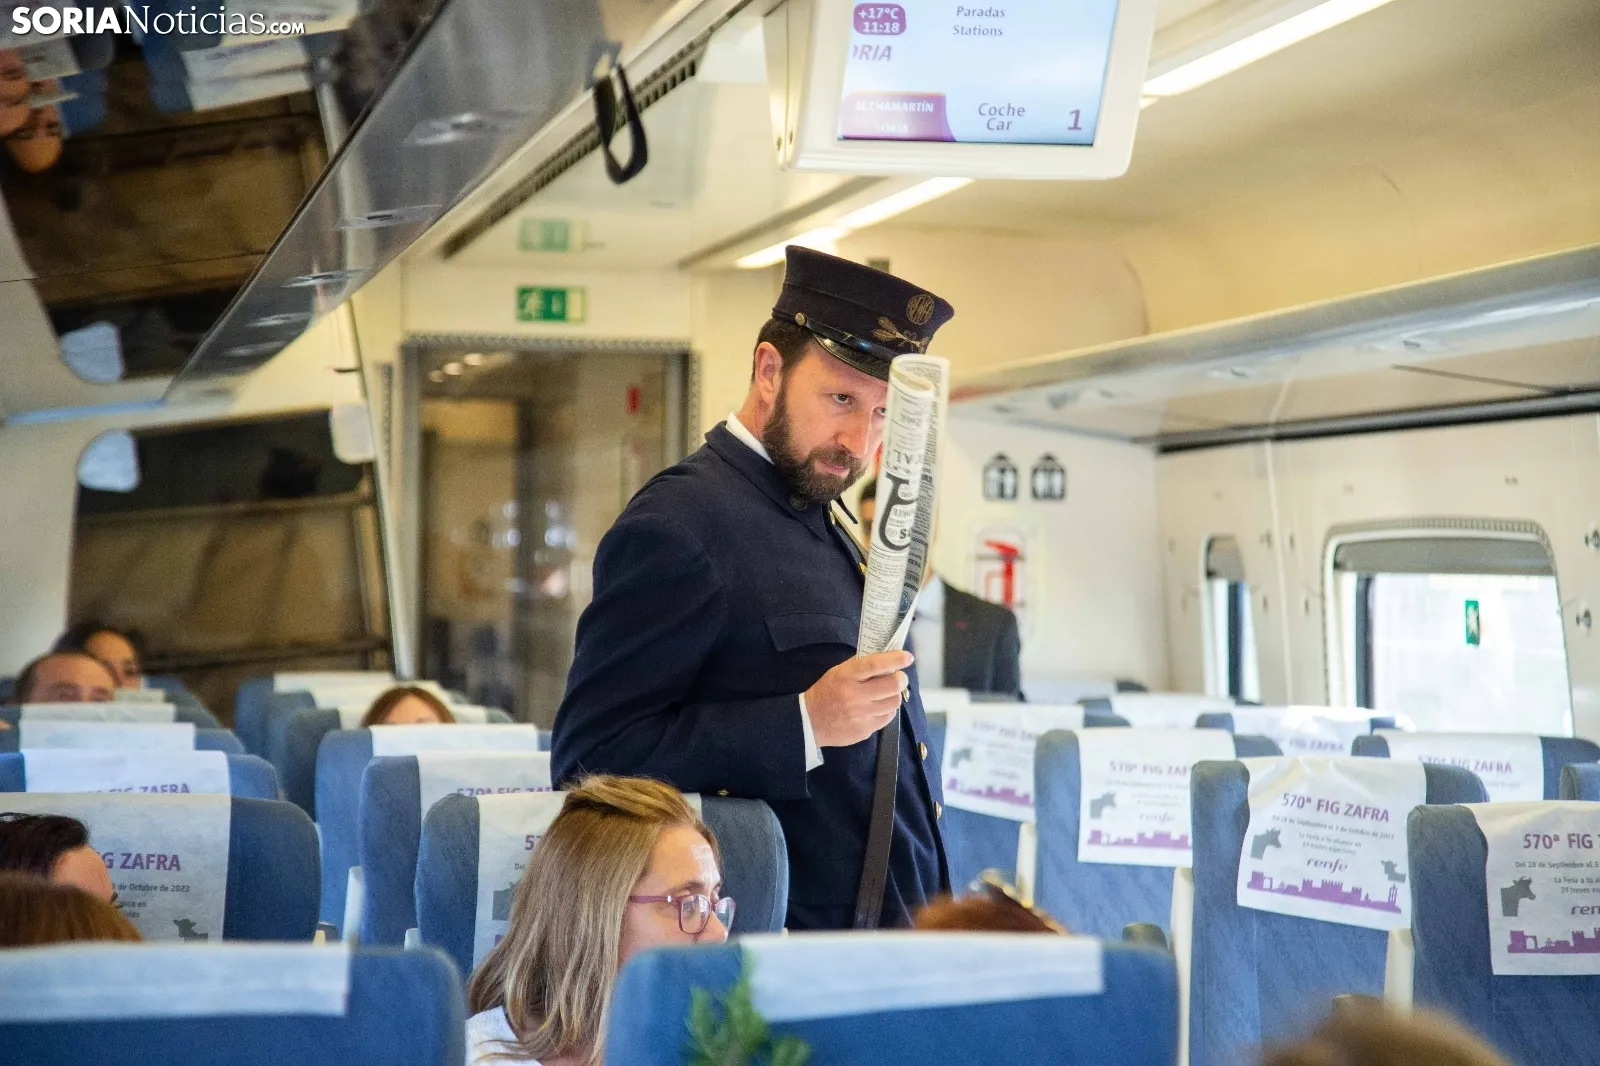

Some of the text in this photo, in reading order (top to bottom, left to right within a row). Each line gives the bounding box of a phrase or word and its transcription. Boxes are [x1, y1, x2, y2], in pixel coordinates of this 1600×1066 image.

[956, 5, 1005, 18] Paradas
[862, 21, 900, 34] 11:18
[952, 24, 1003, 36] Stations
[978, 102, 1026, 117] Coche
[986, 117, 1013, 131] Car
[1067, 108, 1082, 131] 1
[1167, 765, 1190, 777] ZAF
[1474, 760, 1513, 774] ZAFRA
[1316, 798, 1340, 815] FIG
[1343, 803, 1390, 823] ZAFRA
[1567, 833, 1593, 849] FIG
[120, 852, 181, 871] ZAFRA
[1307, 858, 1348, 874] renfe
[1548, 861, 1584, 870] Septiembre
[118, 883, 127, 891] de
[129, 883, 158, 892] Octubre
[160, 884, 169, 892] de
[171, 885, 190, 893] 2023
[1571, 905, 1600, 915] ren
